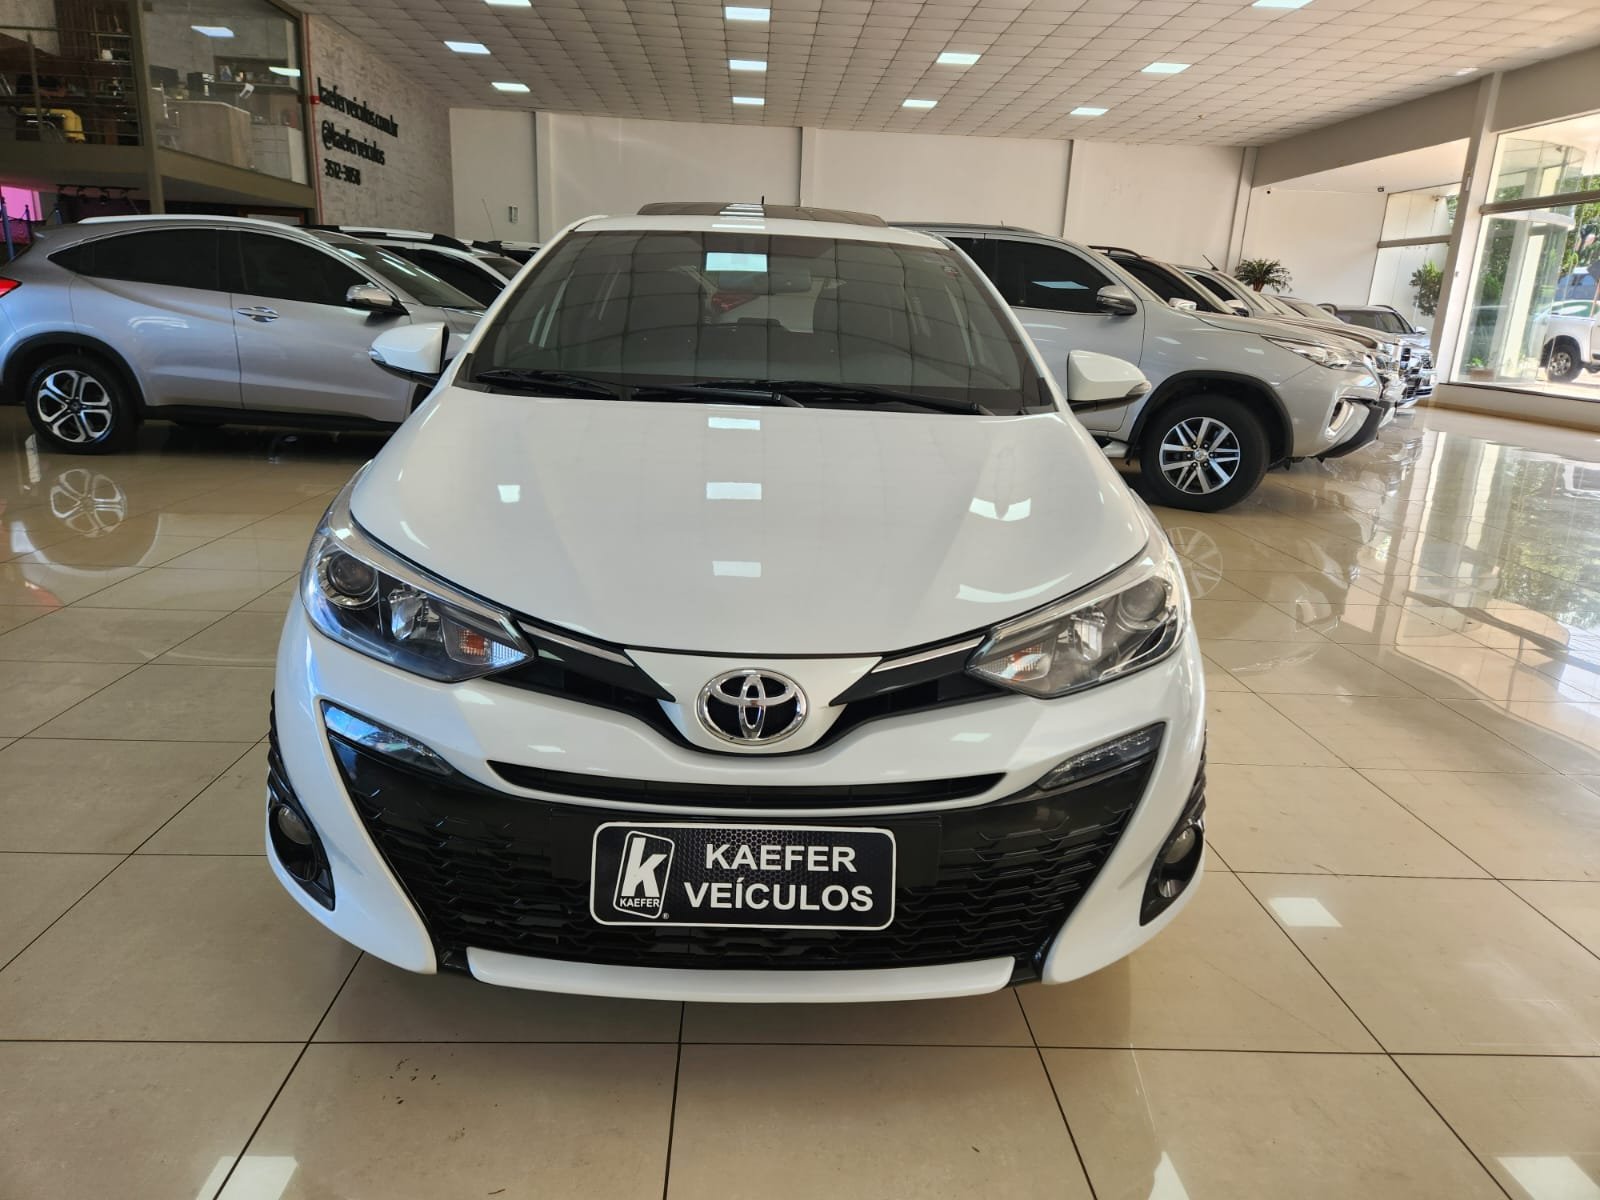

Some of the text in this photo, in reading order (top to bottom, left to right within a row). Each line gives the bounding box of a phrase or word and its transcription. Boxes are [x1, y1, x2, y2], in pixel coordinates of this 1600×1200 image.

[705, 843, 857, 872] KAEFER
[619, 898, 660, 908] KAEFER
[684, 877, 874, 912] VEÍCULOS
